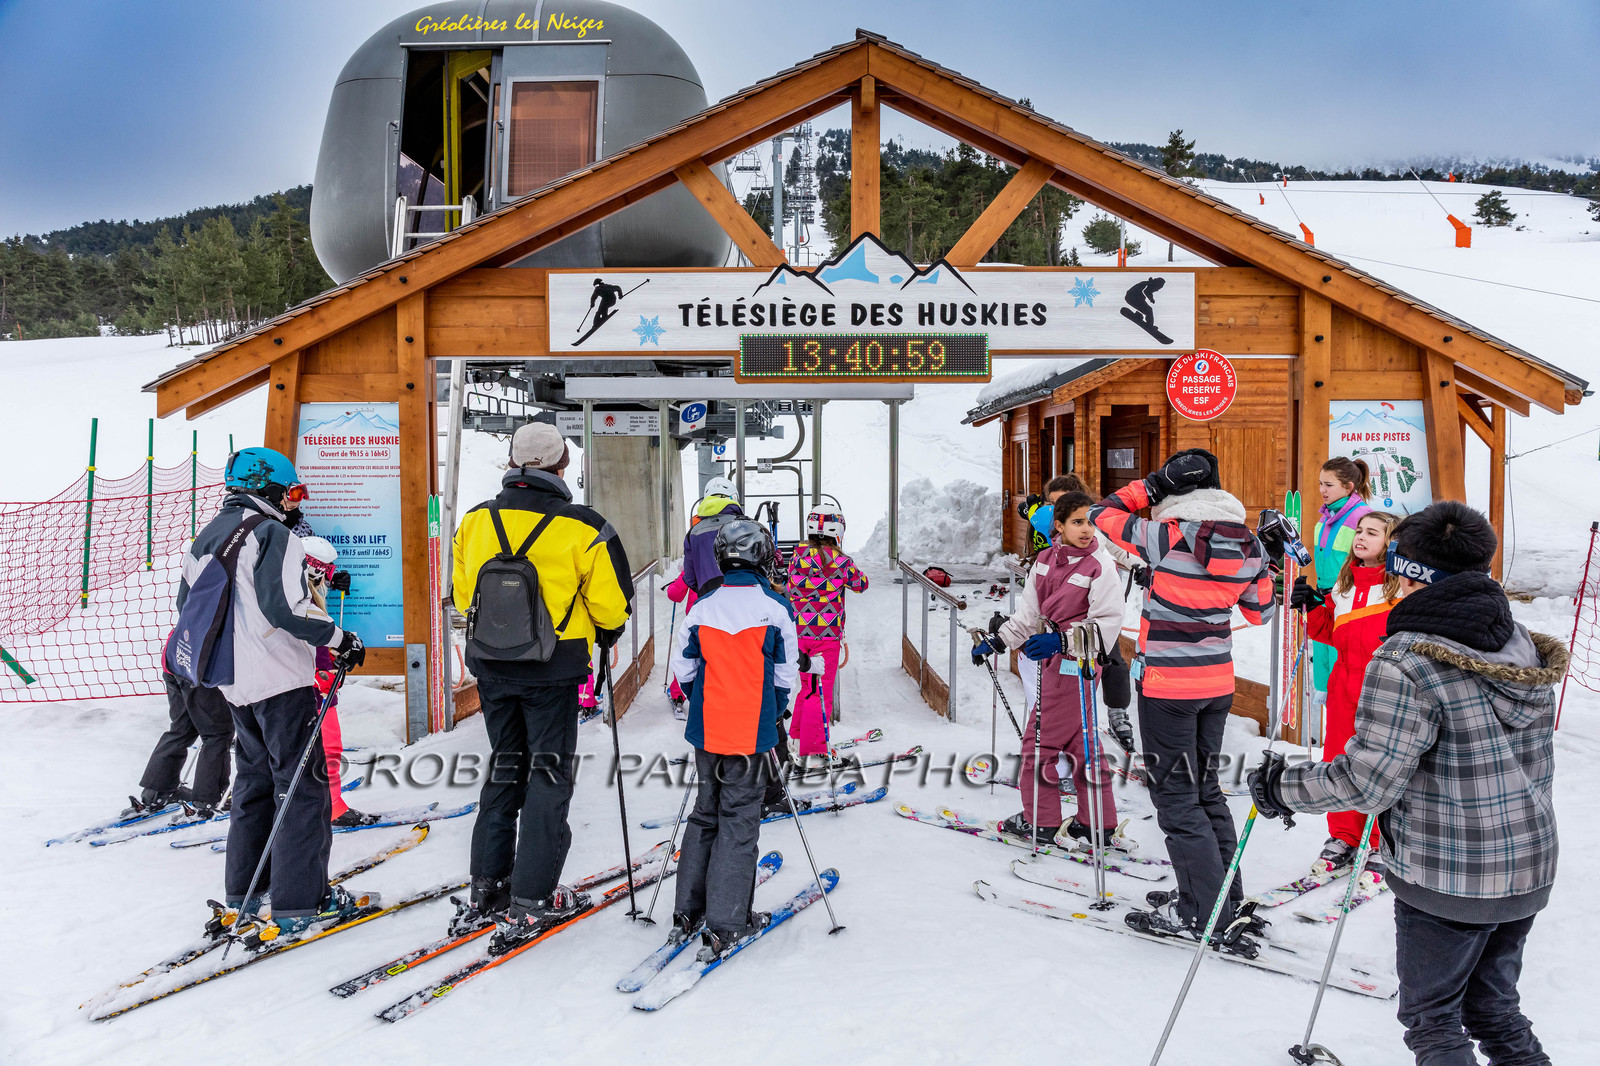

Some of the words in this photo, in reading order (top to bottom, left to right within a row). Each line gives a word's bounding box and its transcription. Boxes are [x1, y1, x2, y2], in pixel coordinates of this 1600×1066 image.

[415, 14, 508, 34] Gréolières
[514, 13, 539, 30] les
[546, 12, 604, 38] Neiges
[678, 296, 836, 327] TÉLÉSIÈGE
[850, 302, 903, 326] DES
[918, 302, 1047, 326] HUSKIES
[783, 340, 946, 370] 13:40:59
[1170, 363, 1184, 388] ECOLE
[1182, 354, 1194, 364] DU
[304, 434, 346, 445] TÉLÉSIÈGE
[350, 436, 366, 445] DES
[1342, 432, 1362, 441] PLAN
[1366, 432, 1380, 441] DES
[1384, 432, 1410, 441] PISTES
[317, 535, 350, 544] SKIES
[353, 535, 366, 544] SKI
[369, 535, 386, 544] LIFT
